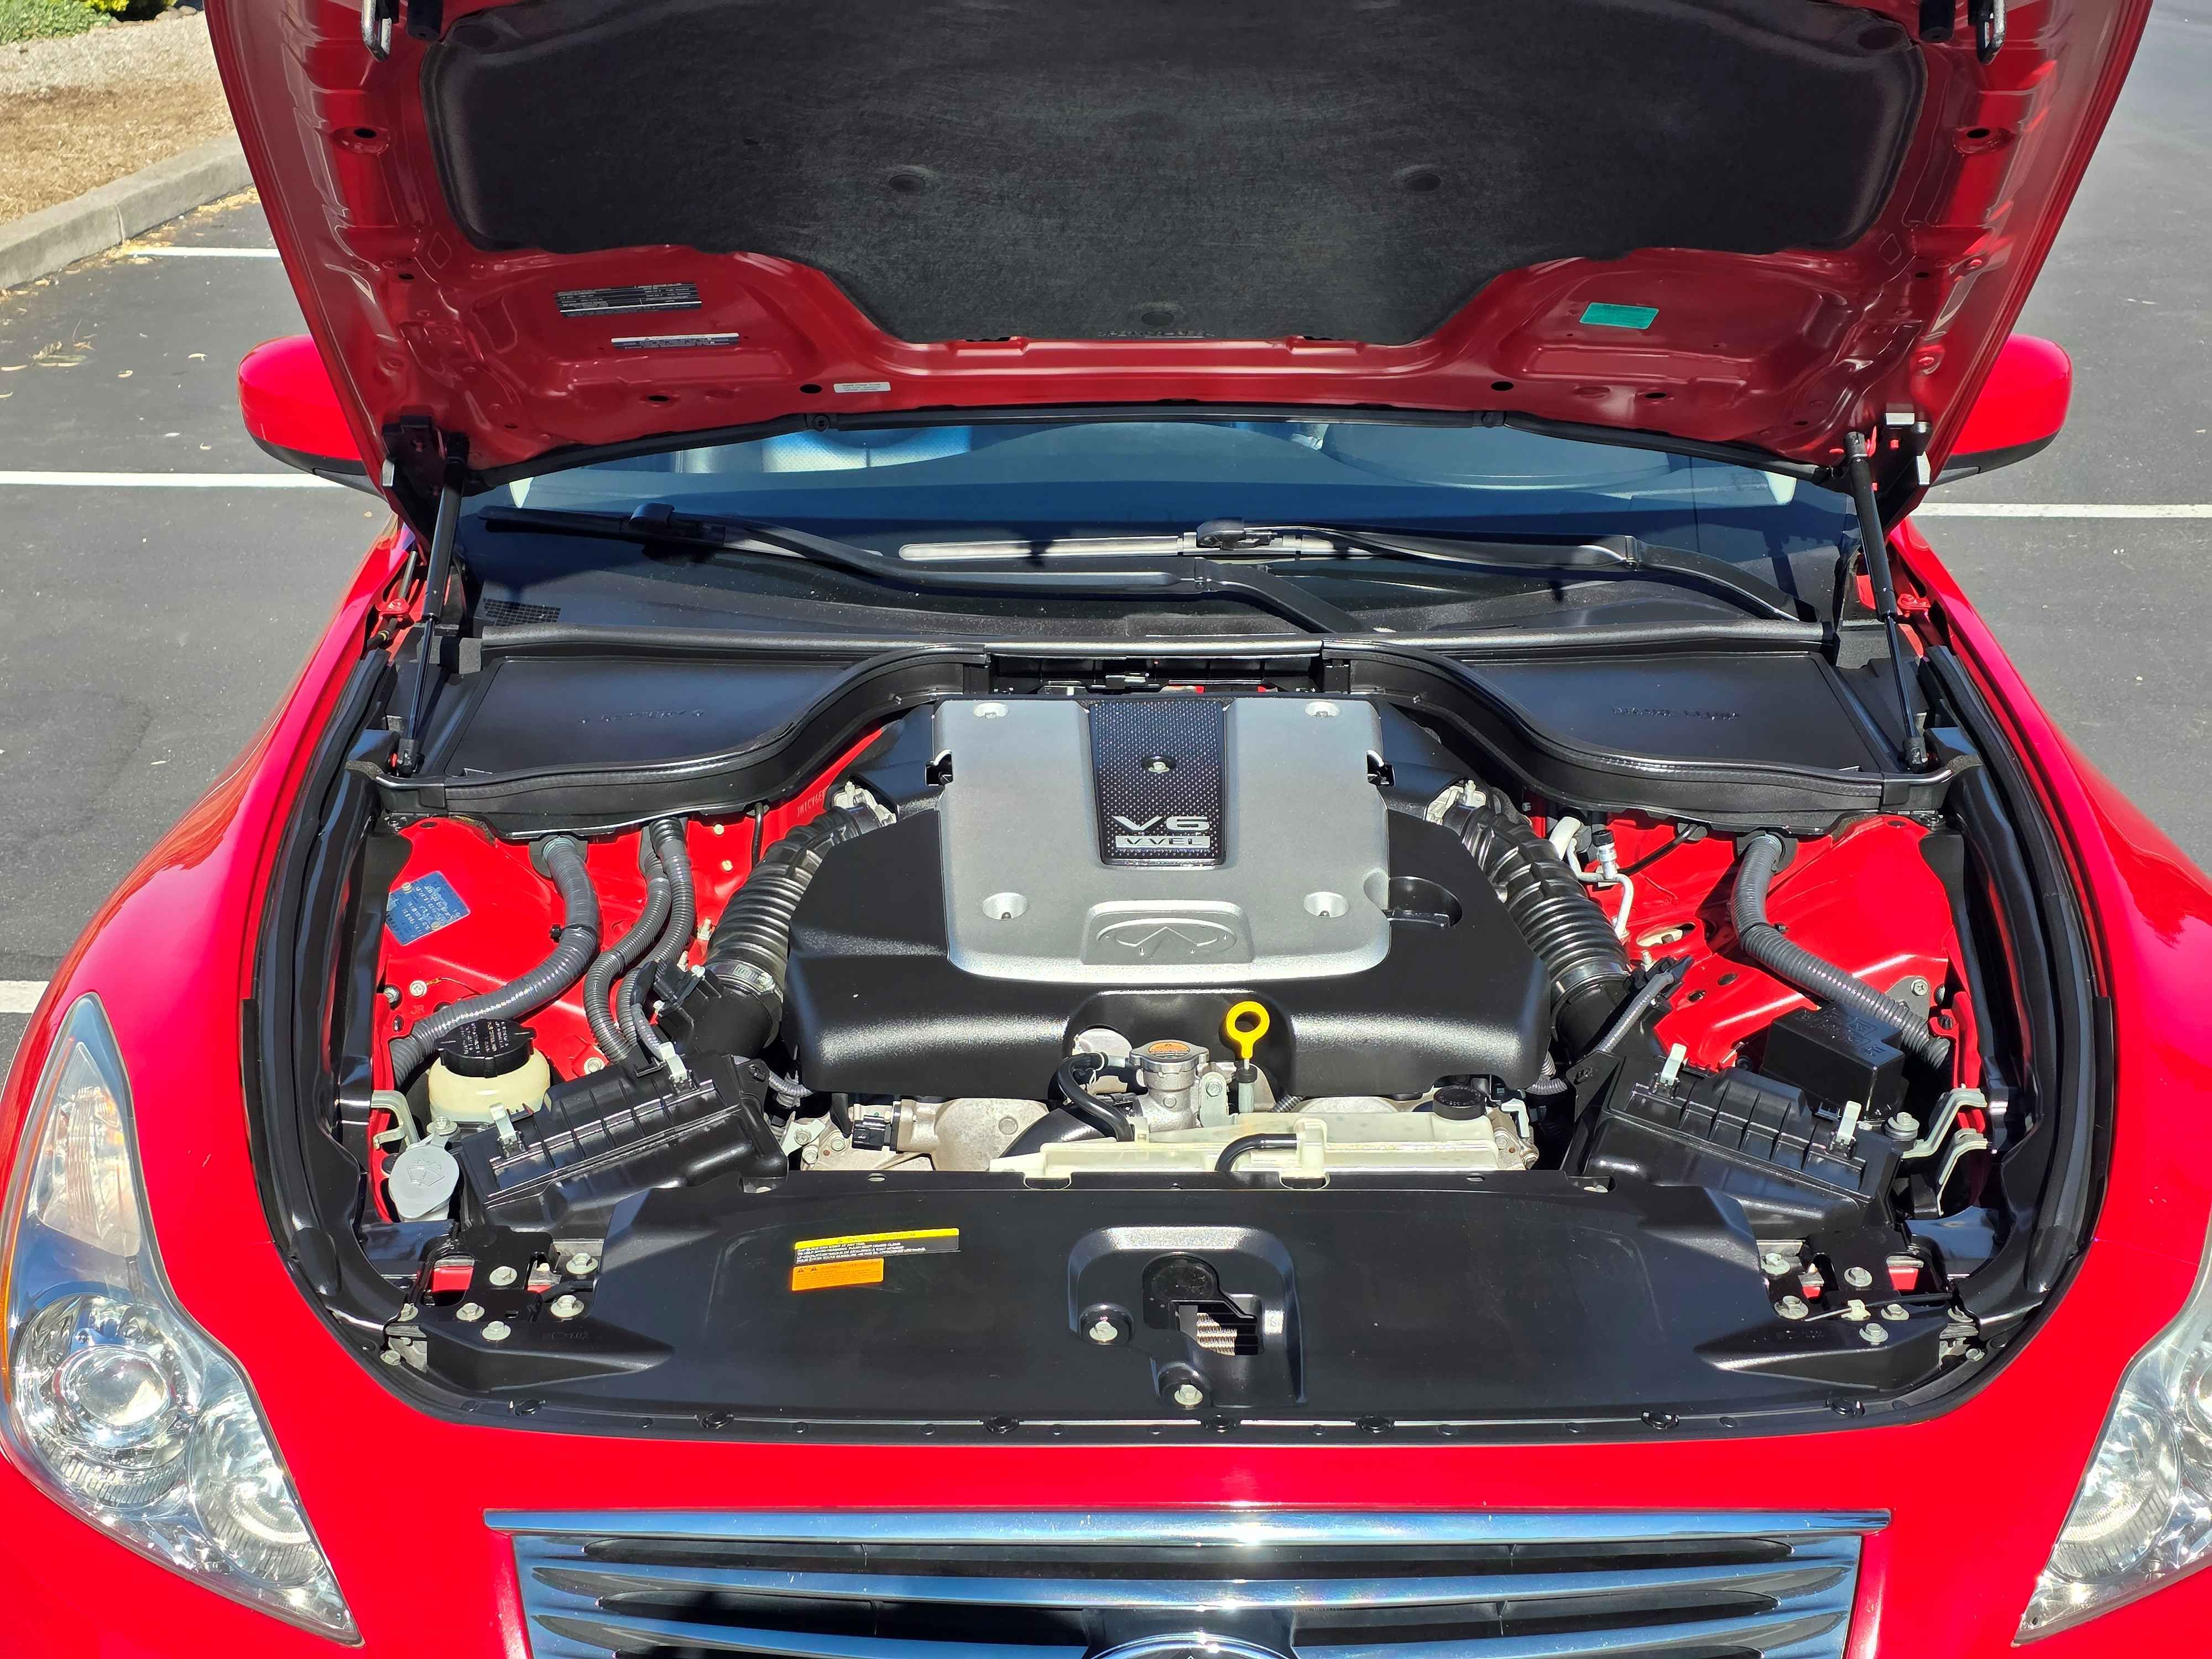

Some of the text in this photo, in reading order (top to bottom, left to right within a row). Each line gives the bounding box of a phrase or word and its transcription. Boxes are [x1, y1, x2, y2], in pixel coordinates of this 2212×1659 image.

[1112, 815, 1209, 831] V6
[1125, 837, 1204, 846] VVEL
[410, 1004, 425, 1015] JR
